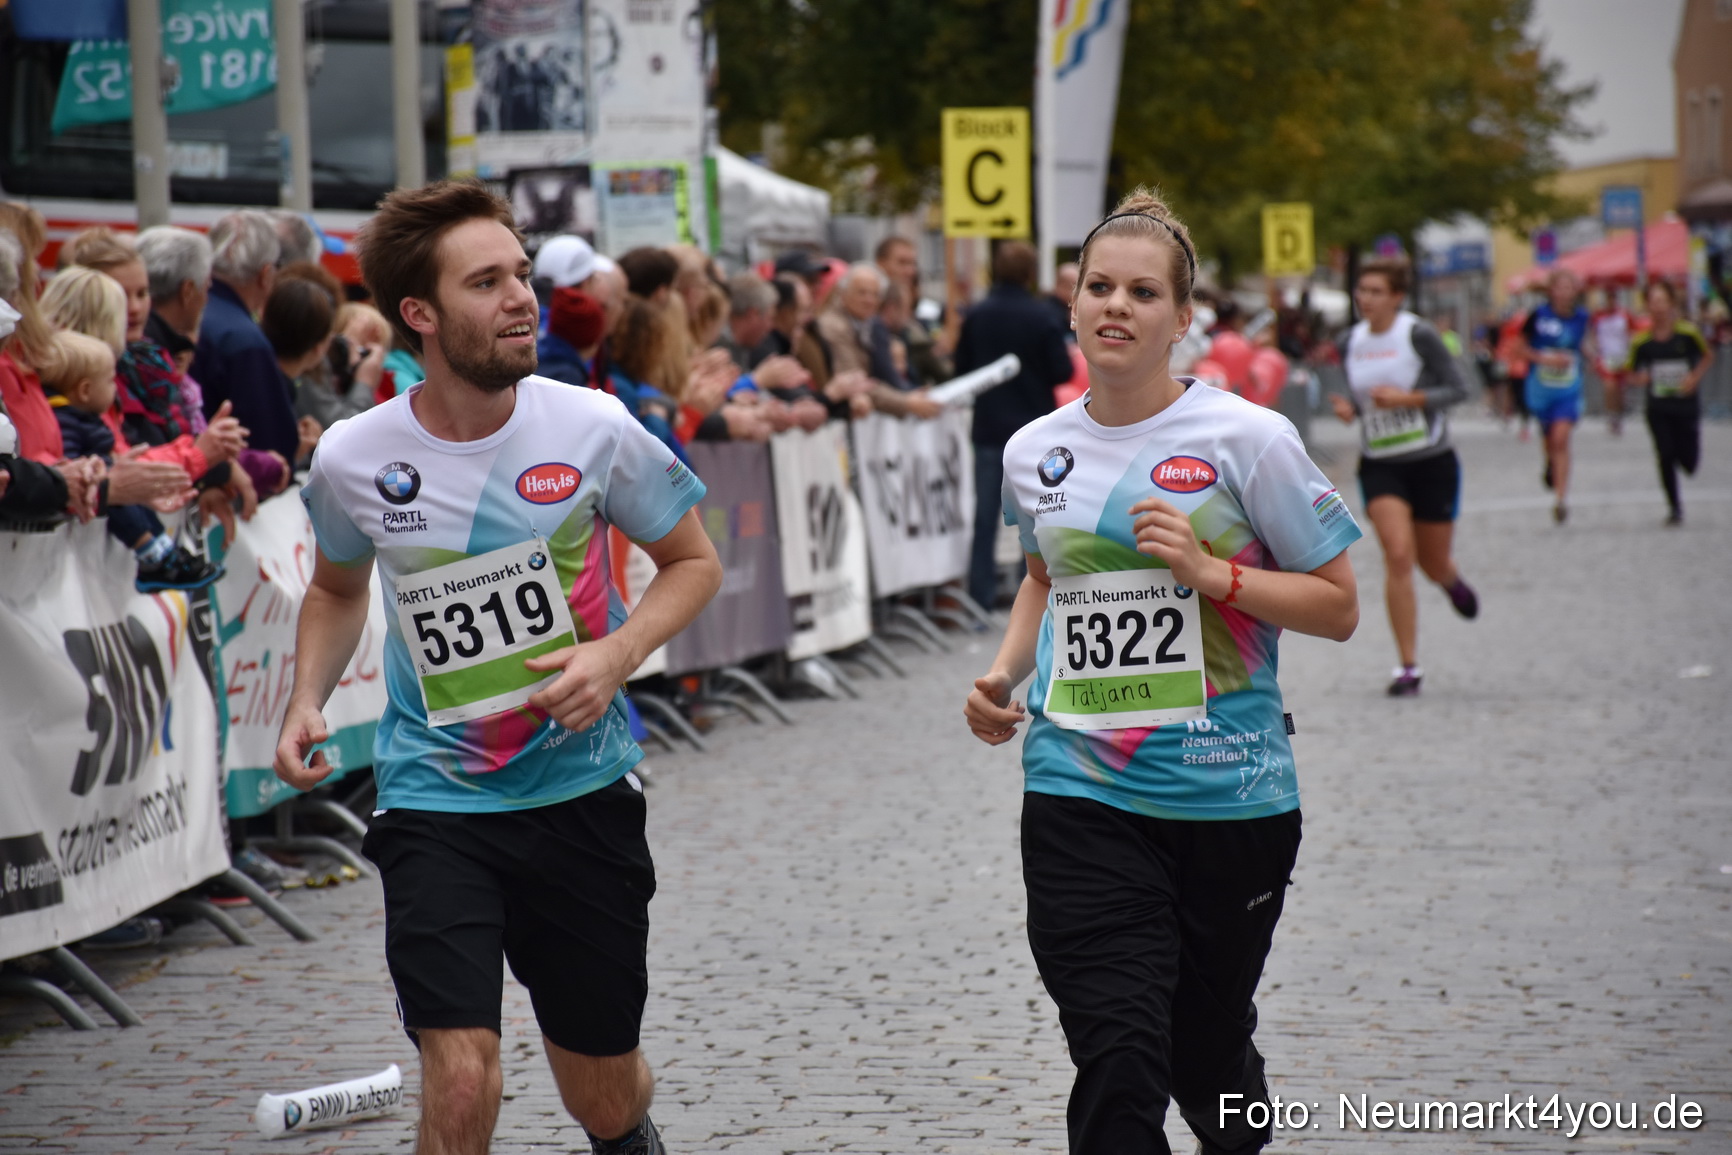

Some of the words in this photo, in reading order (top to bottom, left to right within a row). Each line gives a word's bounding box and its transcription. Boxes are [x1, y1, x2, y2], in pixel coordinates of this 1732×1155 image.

[965, 147, 1005, 207] C
[525, 474, 575, 494] Hervis
[1159, 465, 1210, 483] Hervis
[1035, 503, 1067, 515] Neumarkt
[1038, 491, 1067, 507] PARTL
[382, 510, 426, 525] PARTL
[384, 523, 427, 534] Neumarkt
[396, 586, 441, 606] PARTL
[442, 562, 523, 596] Neumarkt
[1056, 591, 1090, 606] PARTL
[1092, 585, 1167, 604] Neumarkt
[412, 581, 554, 666] 5319
[1066, 607, 1187, 671] 5322
[1063, 681, 1152, 712] Tatjana
[1182, 731, 1261, 748] Neumarkter
[1182, 747, 1249, 765] Stadtlauf
[308, 1091, 345, 1123] BMW
